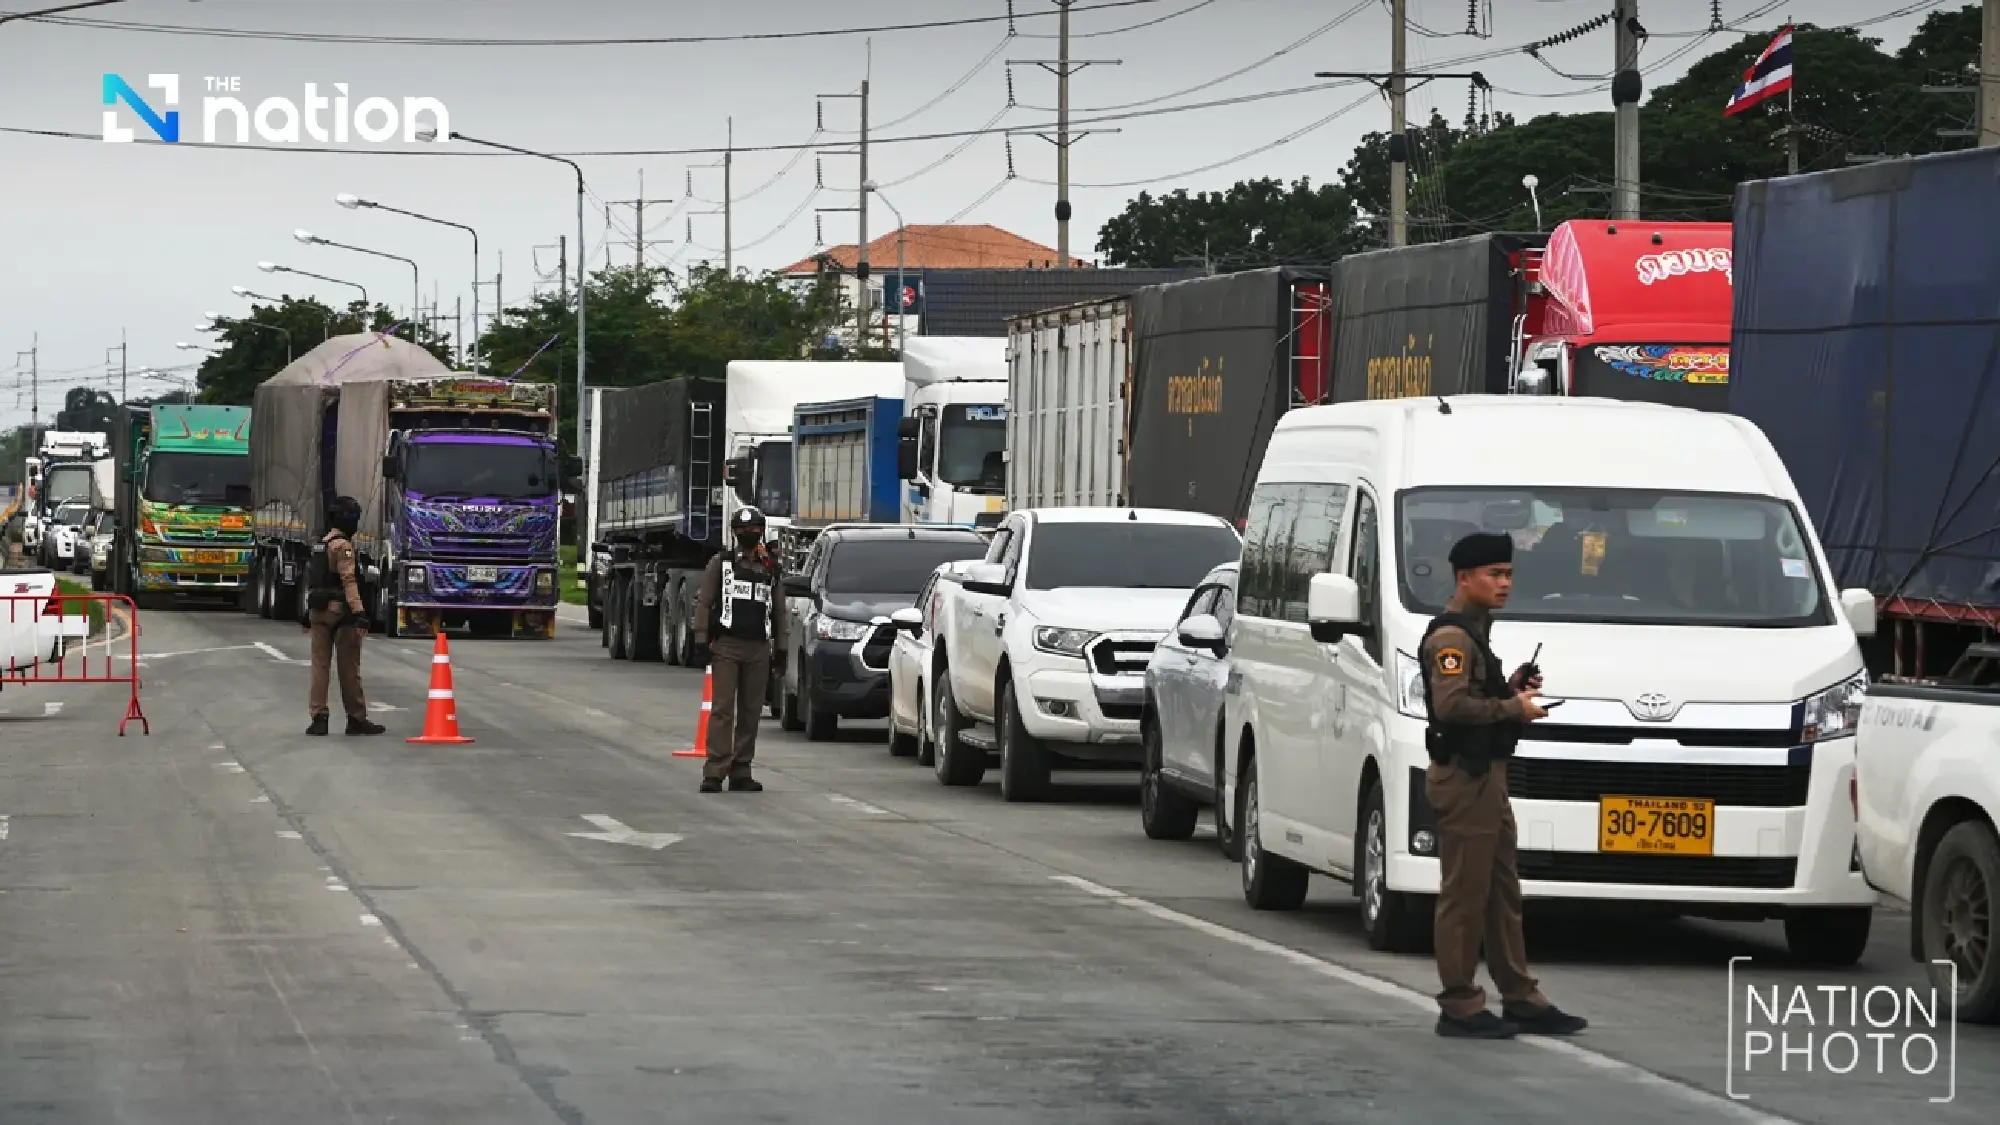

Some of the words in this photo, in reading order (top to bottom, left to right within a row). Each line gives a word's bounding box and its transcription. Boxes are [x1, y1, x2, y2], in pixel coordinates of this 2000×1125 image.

[724, 568, 732, 621] POLICE
[1627, 799, 1689, 811] THAILAND
[1607, 808, 1707, 839] 30-7609
